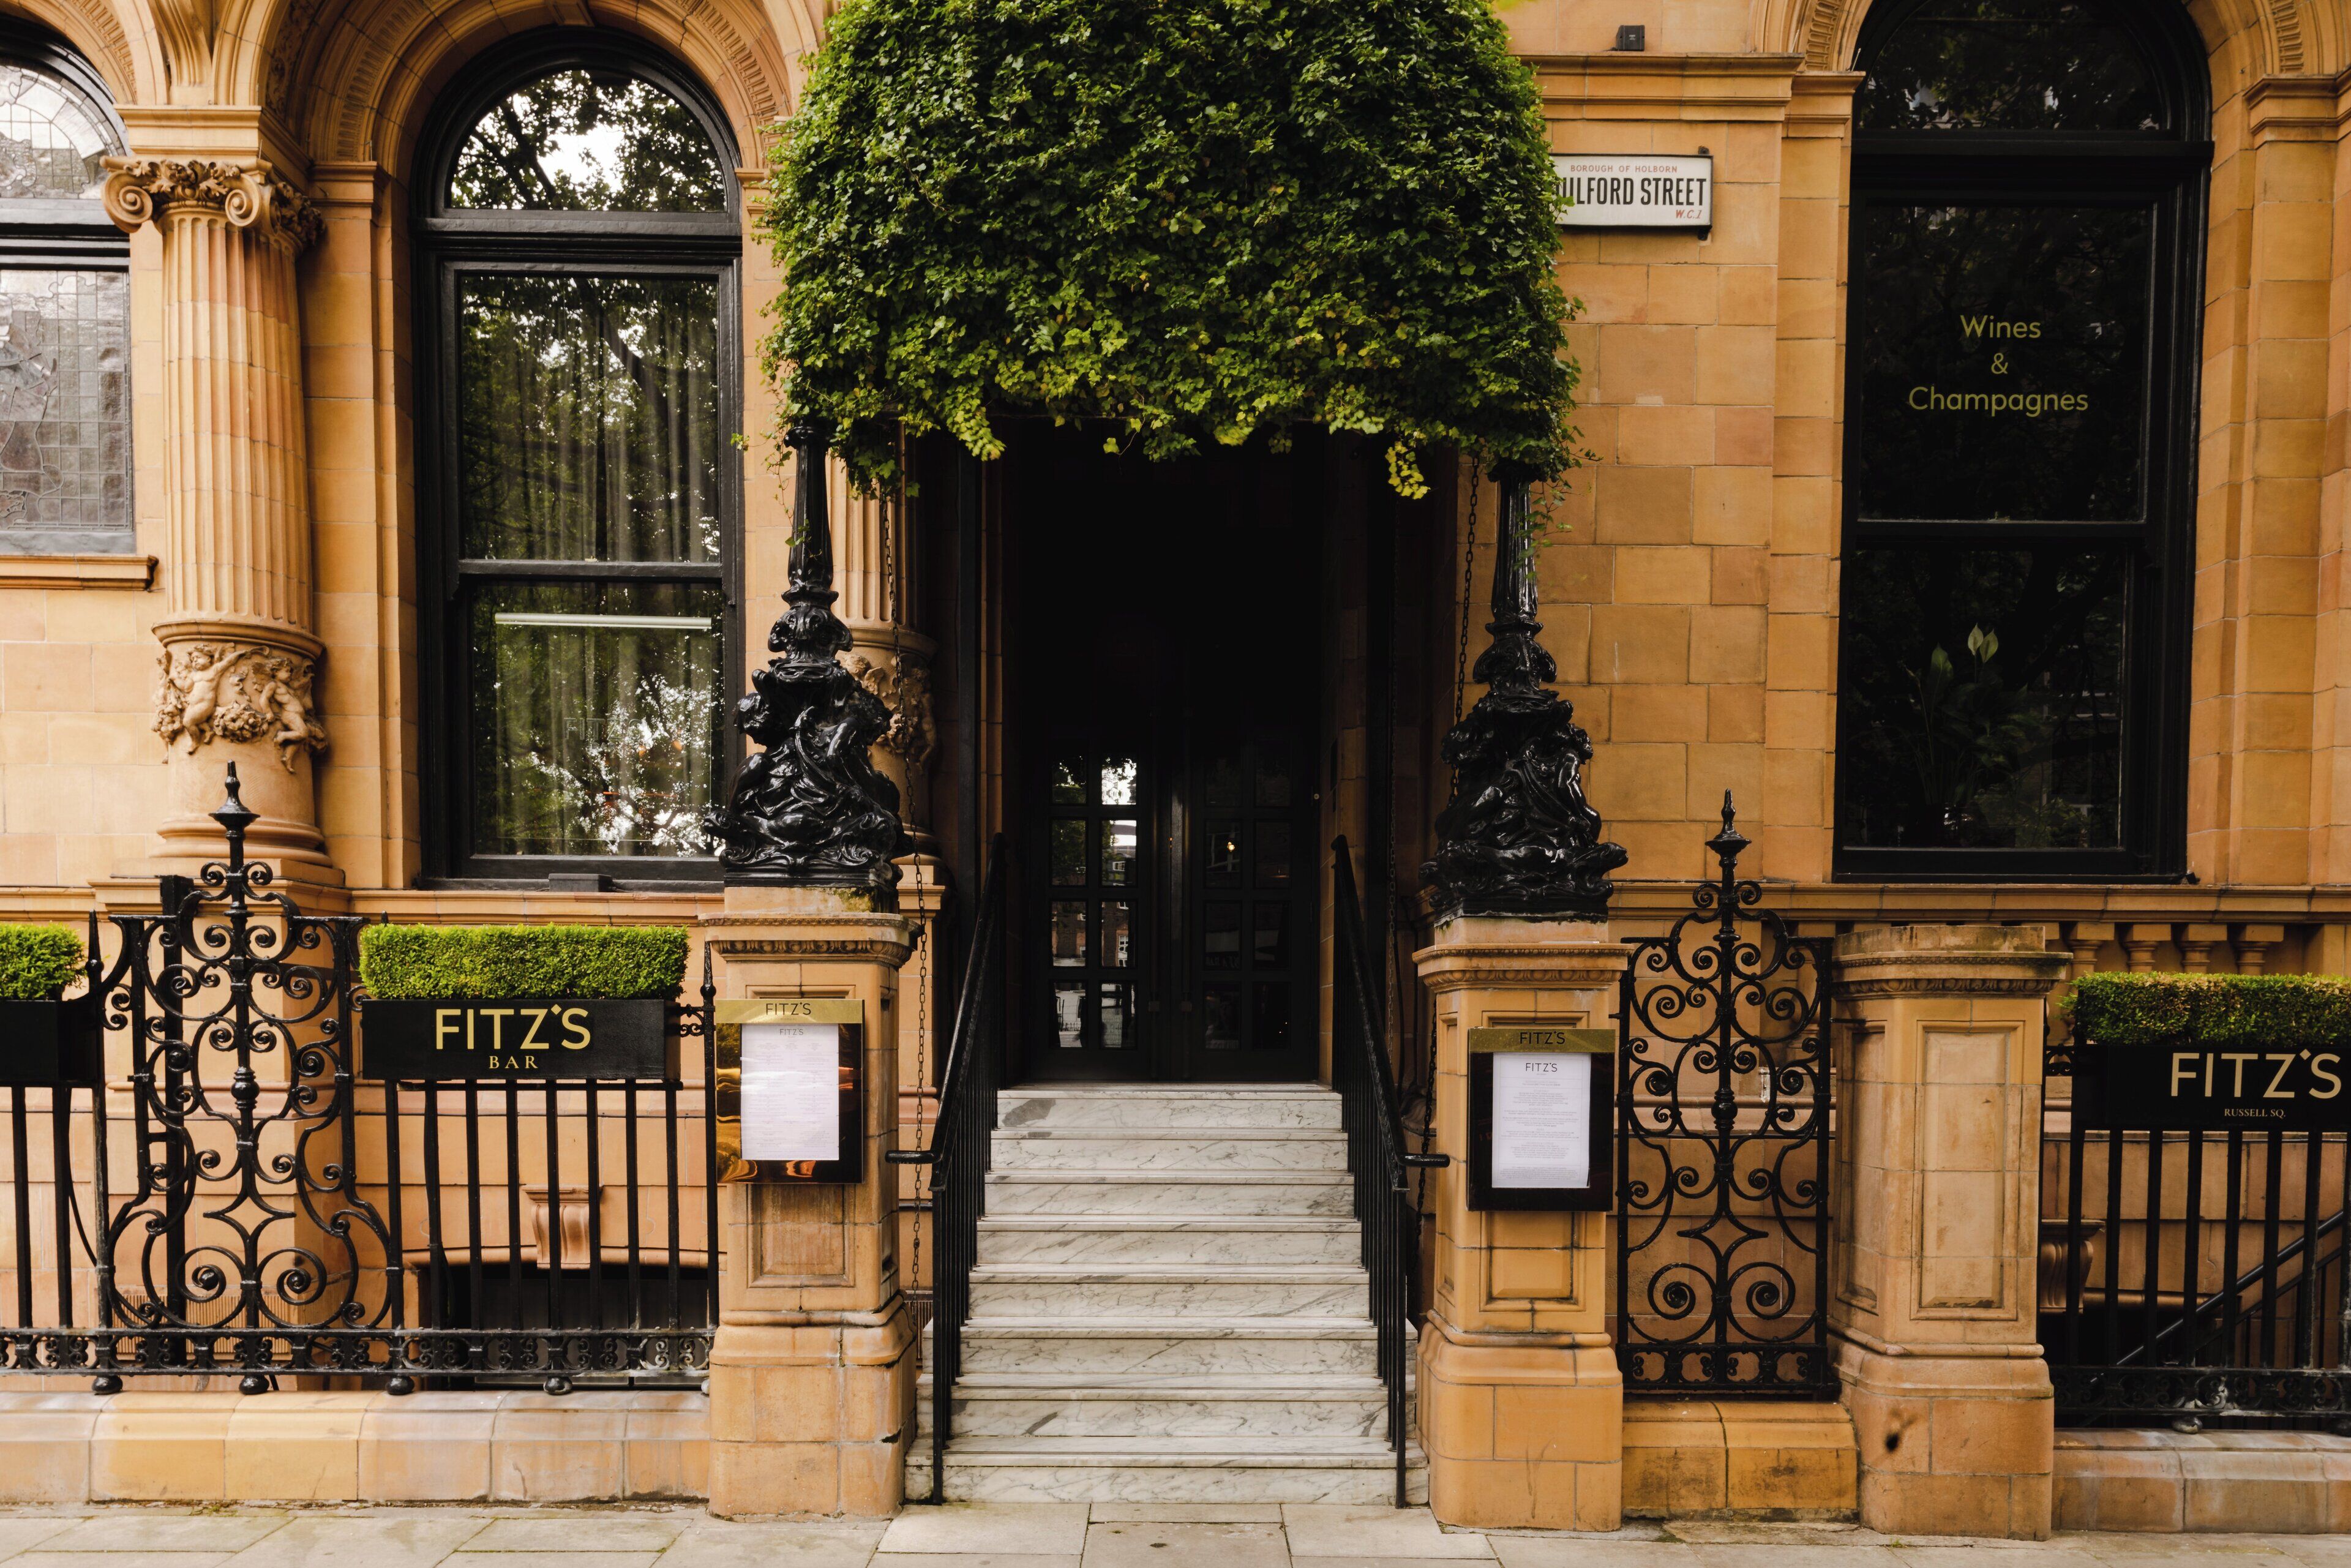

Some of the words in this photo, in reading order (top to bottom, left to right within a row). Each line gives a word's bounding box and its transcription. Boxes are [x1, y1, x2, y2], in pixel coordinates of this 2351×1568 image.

[1555, 177, 1634, 205] UILFORD
[1641, 178, 1707, 206] STREET
[1676, 209, 1702, 219] W.C.1
[1960, 315, 2041, 338] Wines
[1991, 352, 2008, 374] &
[1909, 386, 2089, 418] Champagnes
[766, 1002, 811, 1015] FITZ'S
[436, 1004, 591, 1049] FITZ'S
[1520, 1030, 1565, 1045] FITZ'S
[489, 1056, 538, 1069] BAR
[1526, 1062, 1558, 1072] FITZ'S
[2171, 1049, 2342, 1099] FITZ'S
[2224, 1108, 2268, 1117] RUSSELL
[2270, 1109, 2286, 1119] SQ.
